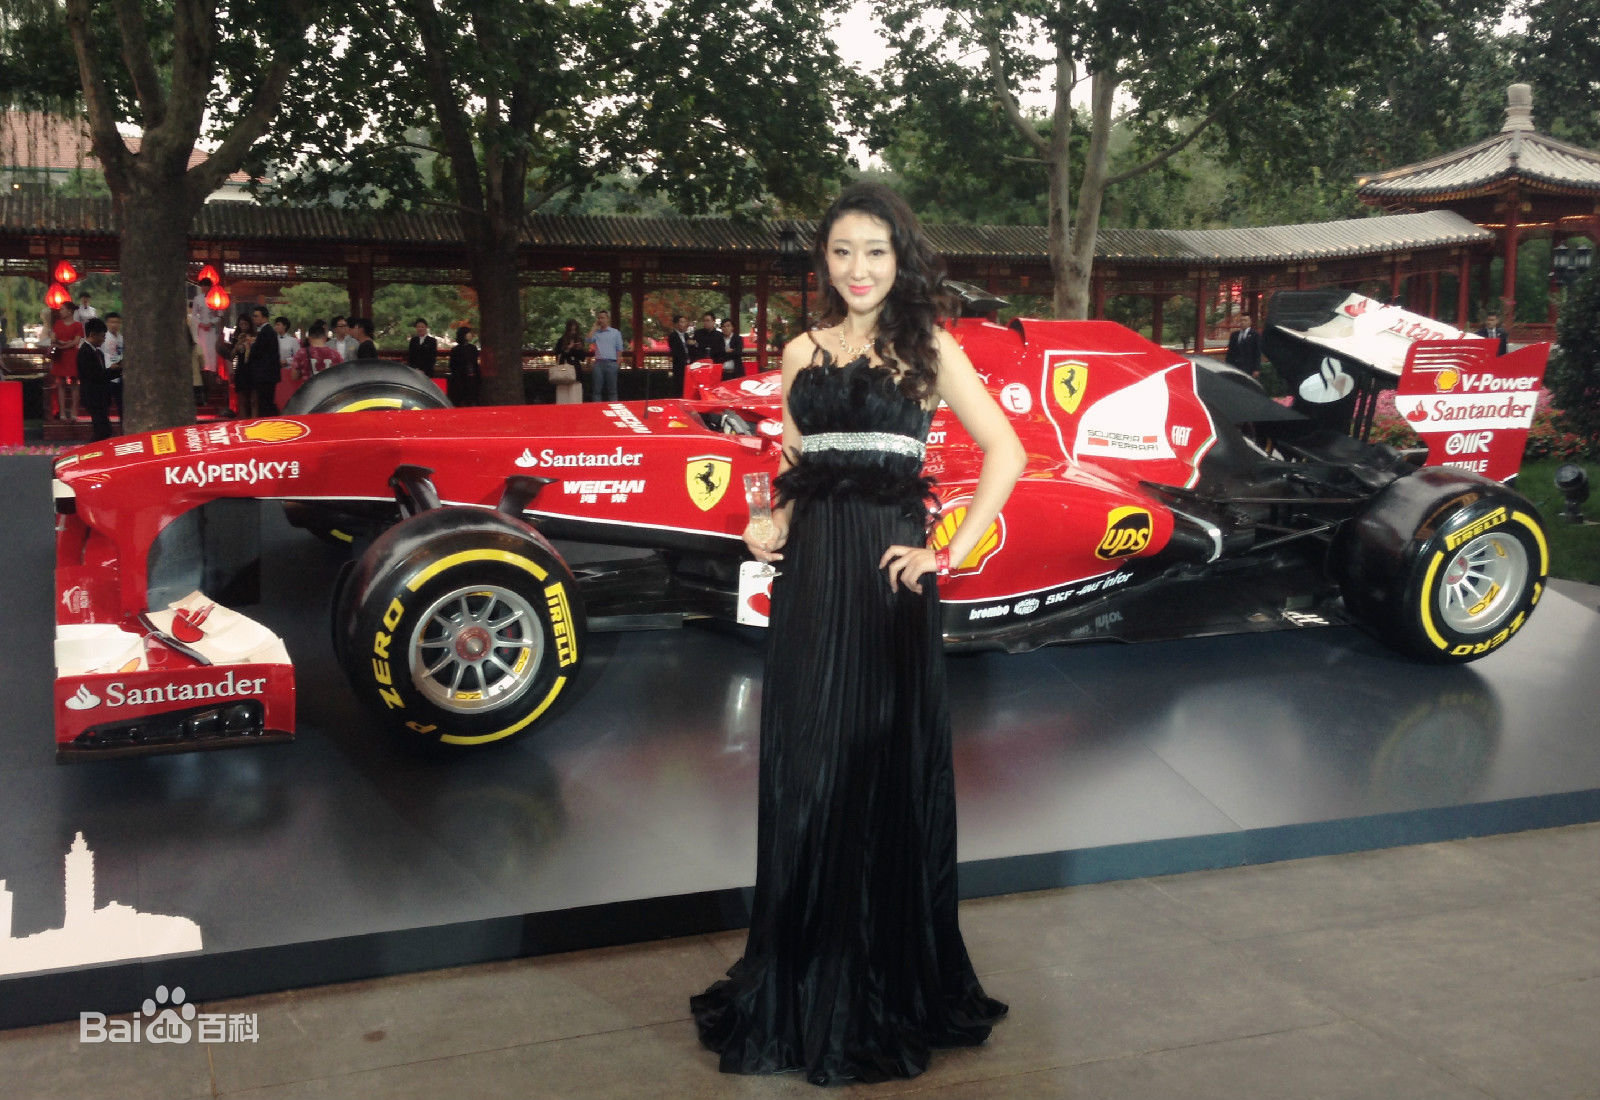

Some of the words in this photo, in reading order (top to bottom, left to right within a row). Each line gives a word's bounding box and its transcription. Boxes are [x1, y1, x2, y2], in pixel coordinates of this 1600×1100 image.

[1461, 373, 1539, 392] V-Power
[1431, 396, 1531, 421] Santander
[1087, 430, 1140, 442] SCUDERIA
[1111, 440, 1159, 451] FERRARI
[1171, 425, 1192, 446] FIAT
[539, 447, 643, 467] Santander
[164, 458, 289, 488] KASPERSKY
[287, 461, 300, 479] lab
[563, 480, 646, 494] WEICHAI
[1444, 506, 1508, 552] PIRELLI
[968, 605, 1010, 621] brembo
[1045, 589, 1075, 606] SKF
[1102, 571, 1134, 590] infor
[543, 581, 578, 668] PIRELLI
[1450, 610, 1526, 656] ZERO
[371, 596, 406, 710] ZERO
[105, 671, 268, 707] Santander
